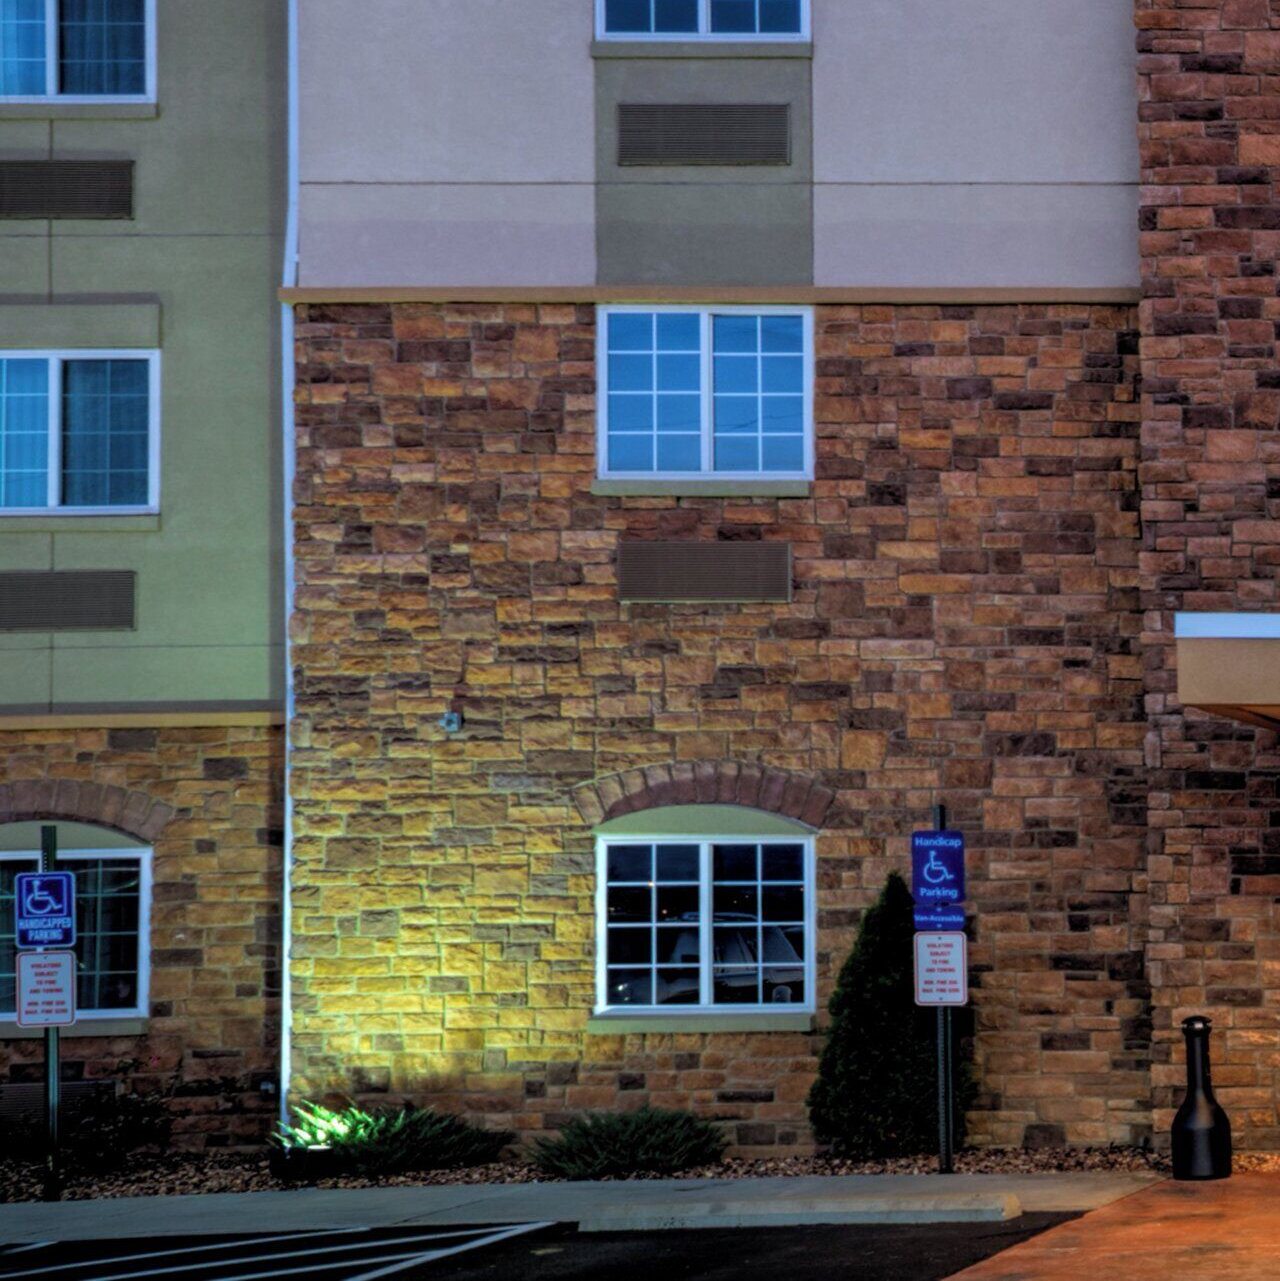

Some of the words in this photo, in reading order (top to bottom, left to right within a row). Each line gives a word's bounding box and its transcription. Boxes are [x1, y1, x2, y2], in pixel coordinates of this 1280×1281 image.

[915, 837, 962, 849] Handicap
[919, 887, 959, 899] Parking
[18, 917, 72, 930] HANDICAPPED
[914, 914, 964, 923] Van-Accessible
[28, 929, 64, 941] PARKING
